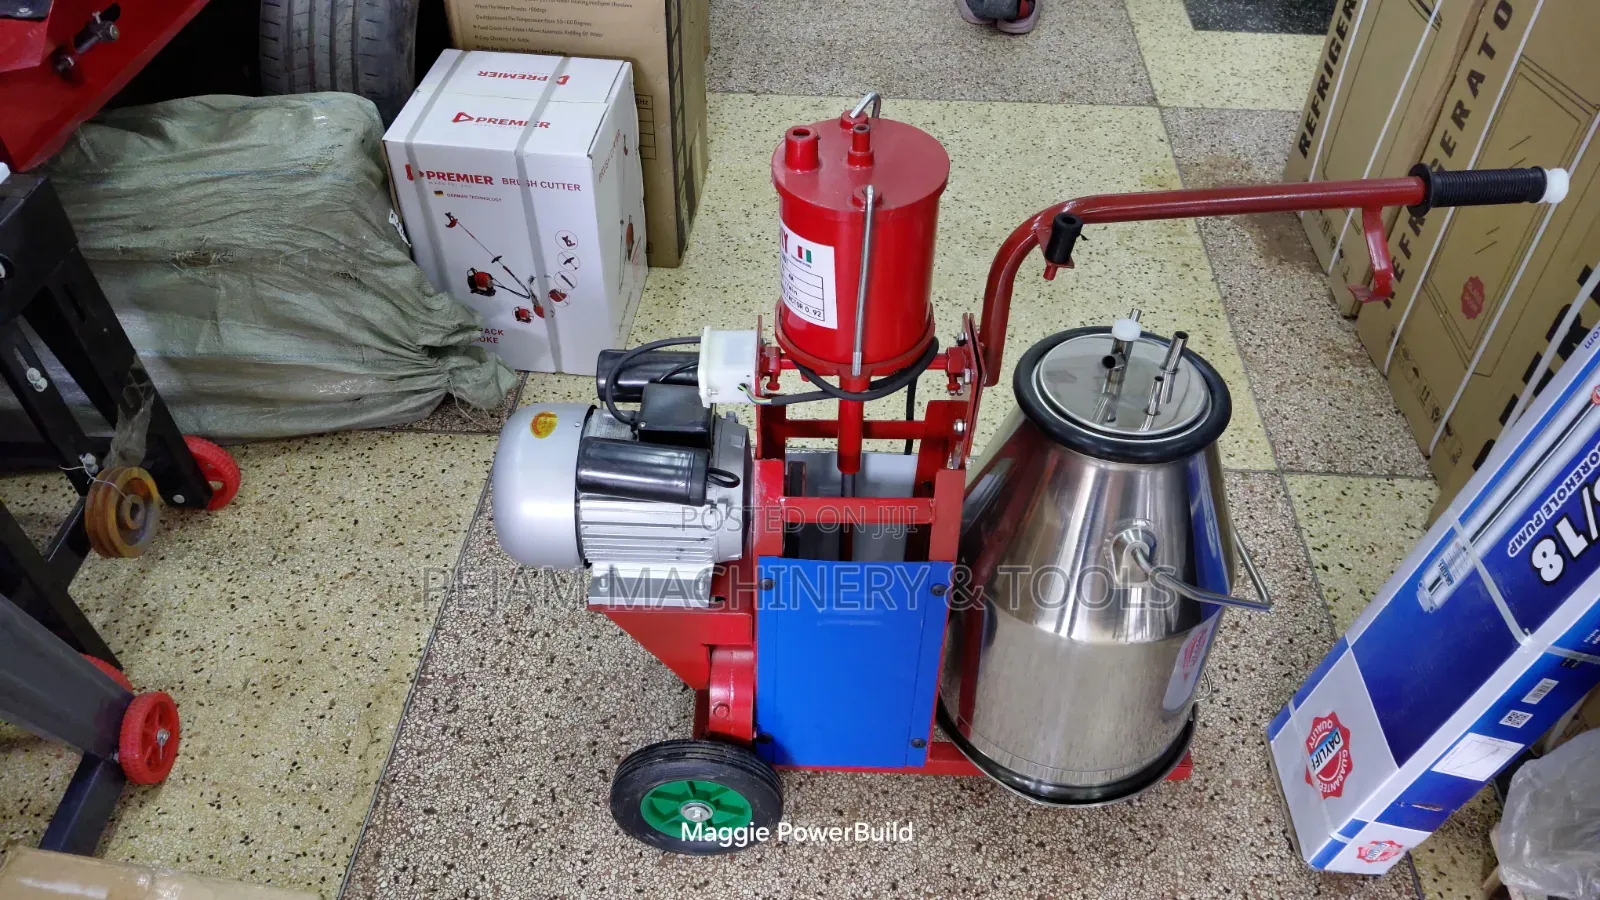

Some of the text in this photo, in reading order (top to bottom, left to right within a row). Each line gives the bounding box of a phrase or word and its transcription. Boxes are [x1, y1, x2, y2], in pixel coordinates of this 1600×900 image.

[477, 70, 548, 81] PREMIER
[425, 170, 494, 185] PREMIER
[540, 180, 581, 192] CUTTER
[1508, 441, 1600, 557] OREHOLE PUMP
[1307, 718, 1334, 750] QUALITY
